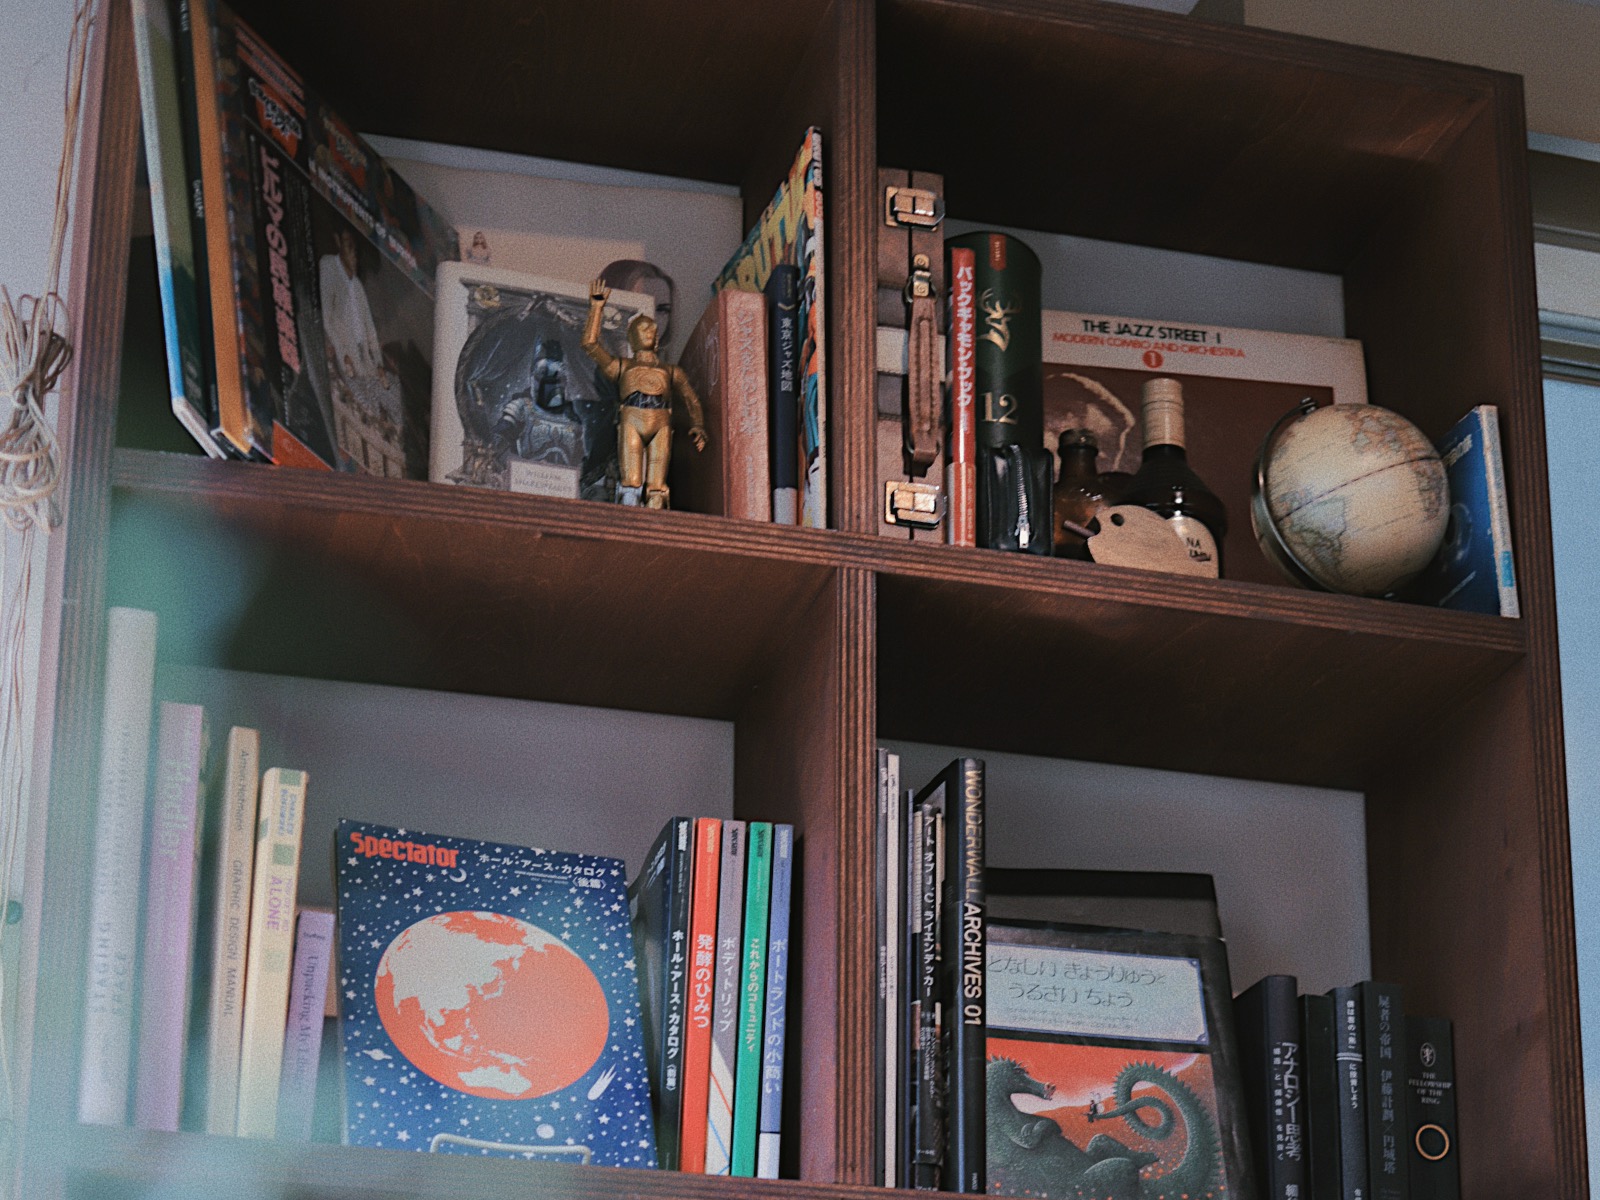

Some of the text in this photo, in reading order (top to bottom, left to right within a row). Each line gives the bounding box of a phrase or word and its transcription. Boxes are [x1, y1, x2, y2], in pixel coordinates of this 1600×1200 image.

[780, 317, 793, 392] 東京ジャズ地図
[1052, 332, 1245, 358] MODERN COMBO AND ORCHESTRA
[1081, 319, 1110, 334] THE
[1114, 322, 1154, 338] JAZZ
[1158, 326, 1208, 343] STREET
[981, 391, 1018, 426] 12
[350, 832, 459, 869] Spectator
[925, 815, 936, 845] アート
[230, 858, 244, 912] GRAPHIC
[479, 852, 606, 879] ホール・アース・カタログ
[266, 875, 282, 931] ALONE
[963, 767, 984, 1026] WONDERWALL ARCHIVES 01
[226, 916, 240, 961] DESIGN
[299, 954, 319, 1024] Unpacking
[667, 930, 684, 1059] ホール・アース・カタログ
[693, 933, 715, 1029] 発酵のひみつ
[718, 937, 737, 1032] ボディトリップ
[745, 938, 760, 1053] これからのコミュニティ
[987, 954, 1168, 986] となしい きょうりゅうと
[1008, 983, 1134, 1008] うるさい ちょう
[764, 939, 789, 1095] ポートランドの小商い
[1282, 1041, 1301, 1162] アナロジー思考
[1408, 1079, 1453, 1089] FELLOWSHIP
